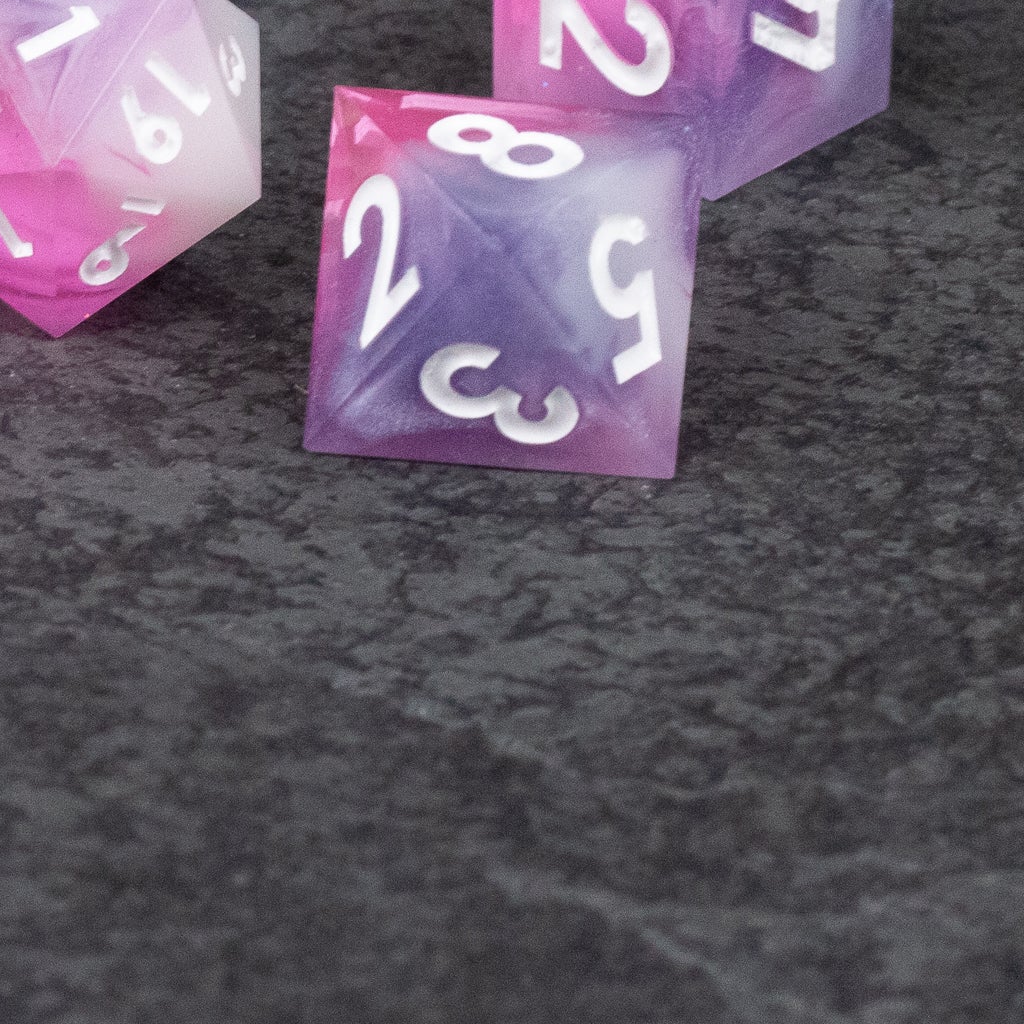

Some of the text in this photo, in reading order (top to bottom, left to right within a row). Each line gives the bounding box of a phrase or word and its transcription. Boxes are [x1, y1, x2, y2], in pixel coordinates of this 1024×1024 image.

[17, 6, 101, 63] 1
[121, 52, 212, 165] 19
[427, 113, 585, 179] 8
[343, 174, 421, 349] 2
[588, 216, 663, 386] 5
[420, 343, 580, 446] 3
